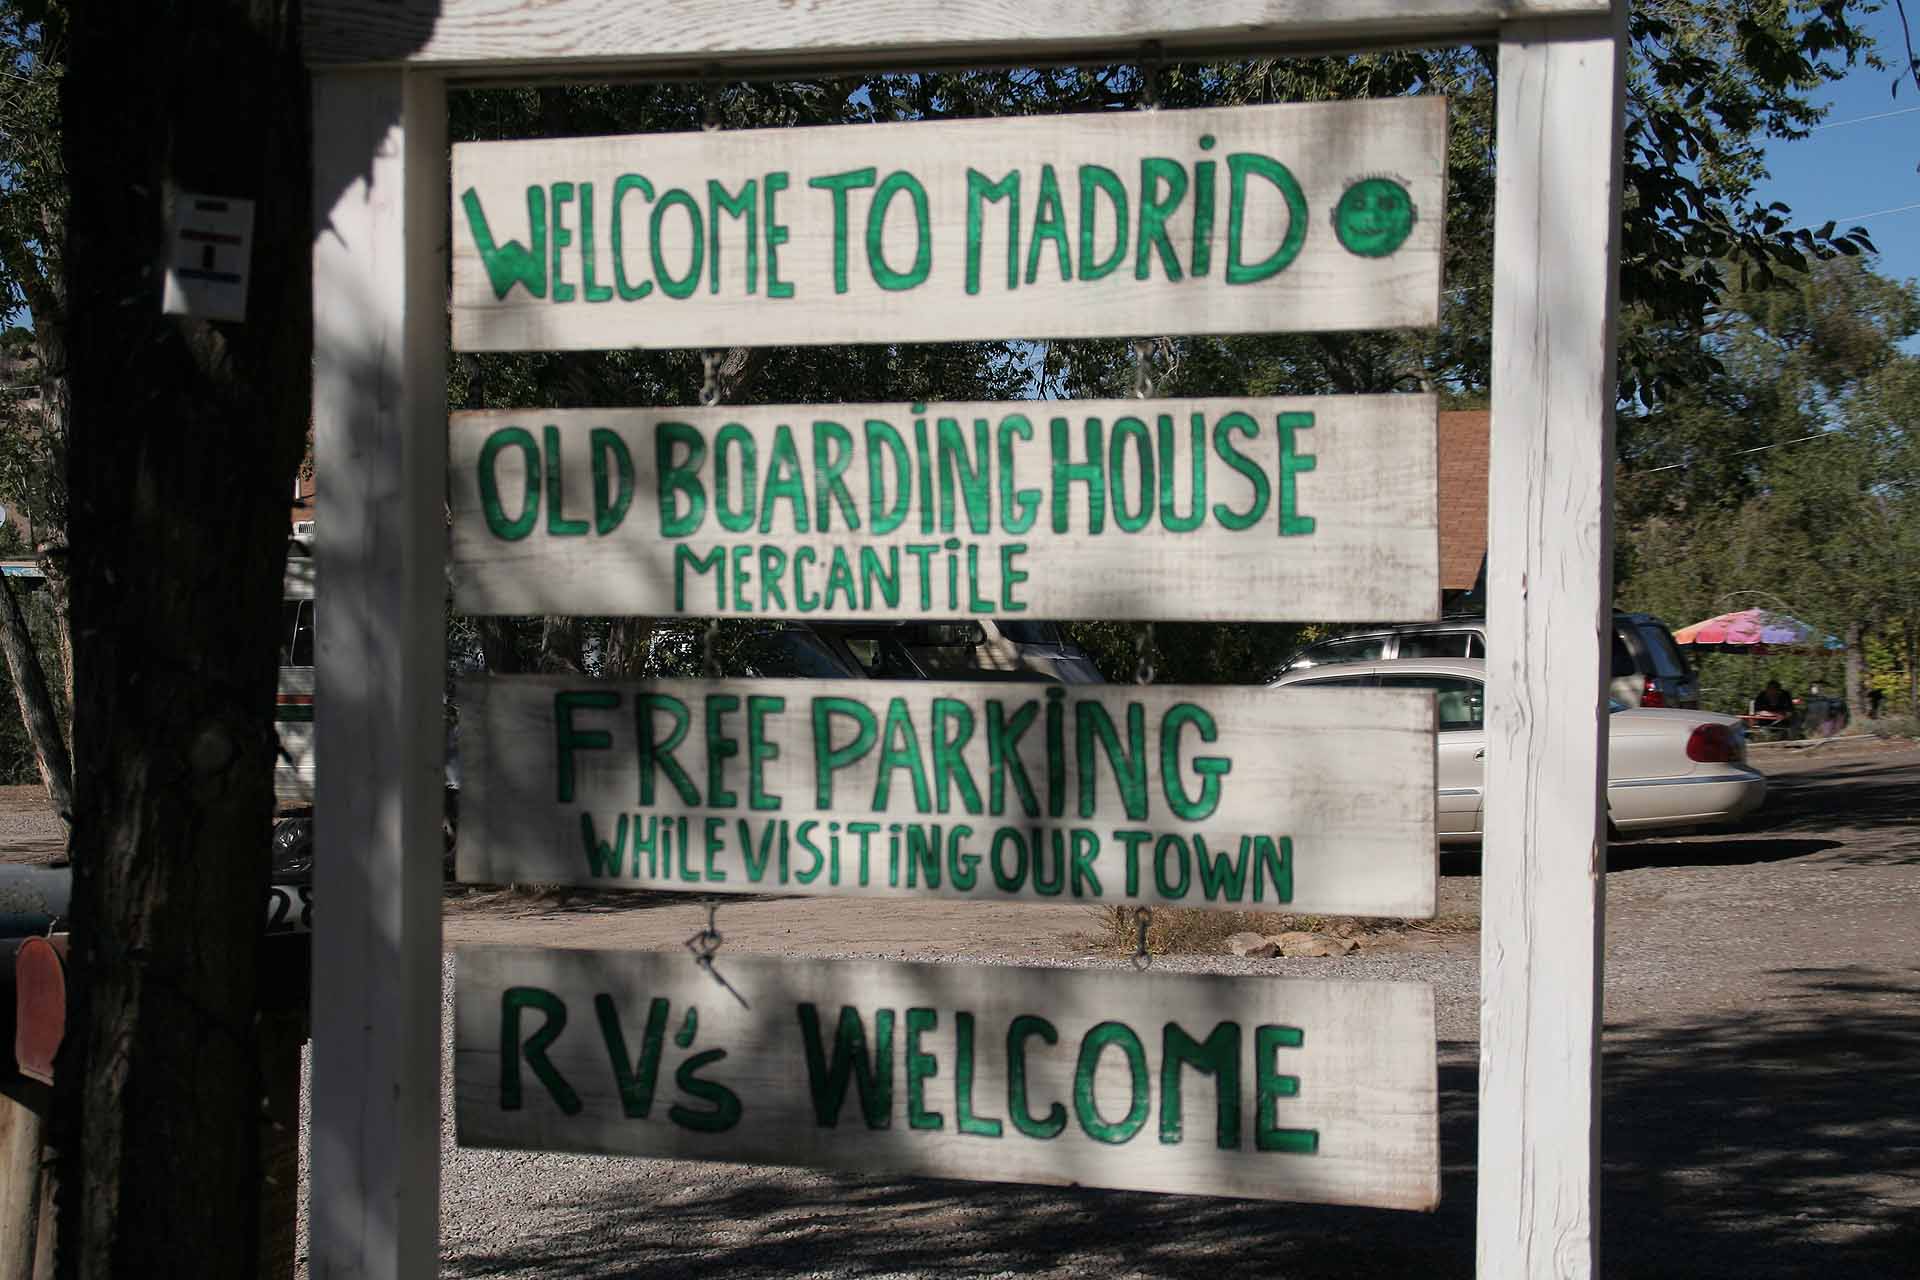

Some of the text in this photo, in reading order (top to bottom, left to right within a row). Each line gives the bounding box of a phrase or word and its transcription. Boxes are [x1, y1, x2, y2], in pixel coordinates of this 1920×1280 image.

[461, 170, 796, 303] WELCOME
[807, 165, 932, 295] TO
[477, 426, 636, 542] OLD
[554, 690, 787, 812] FREE
[989, 825, 1105, 899] OUR
[1112, 829, 1294, 905] TOWN
[796, 1000, 1321, 1155] WELCOME
